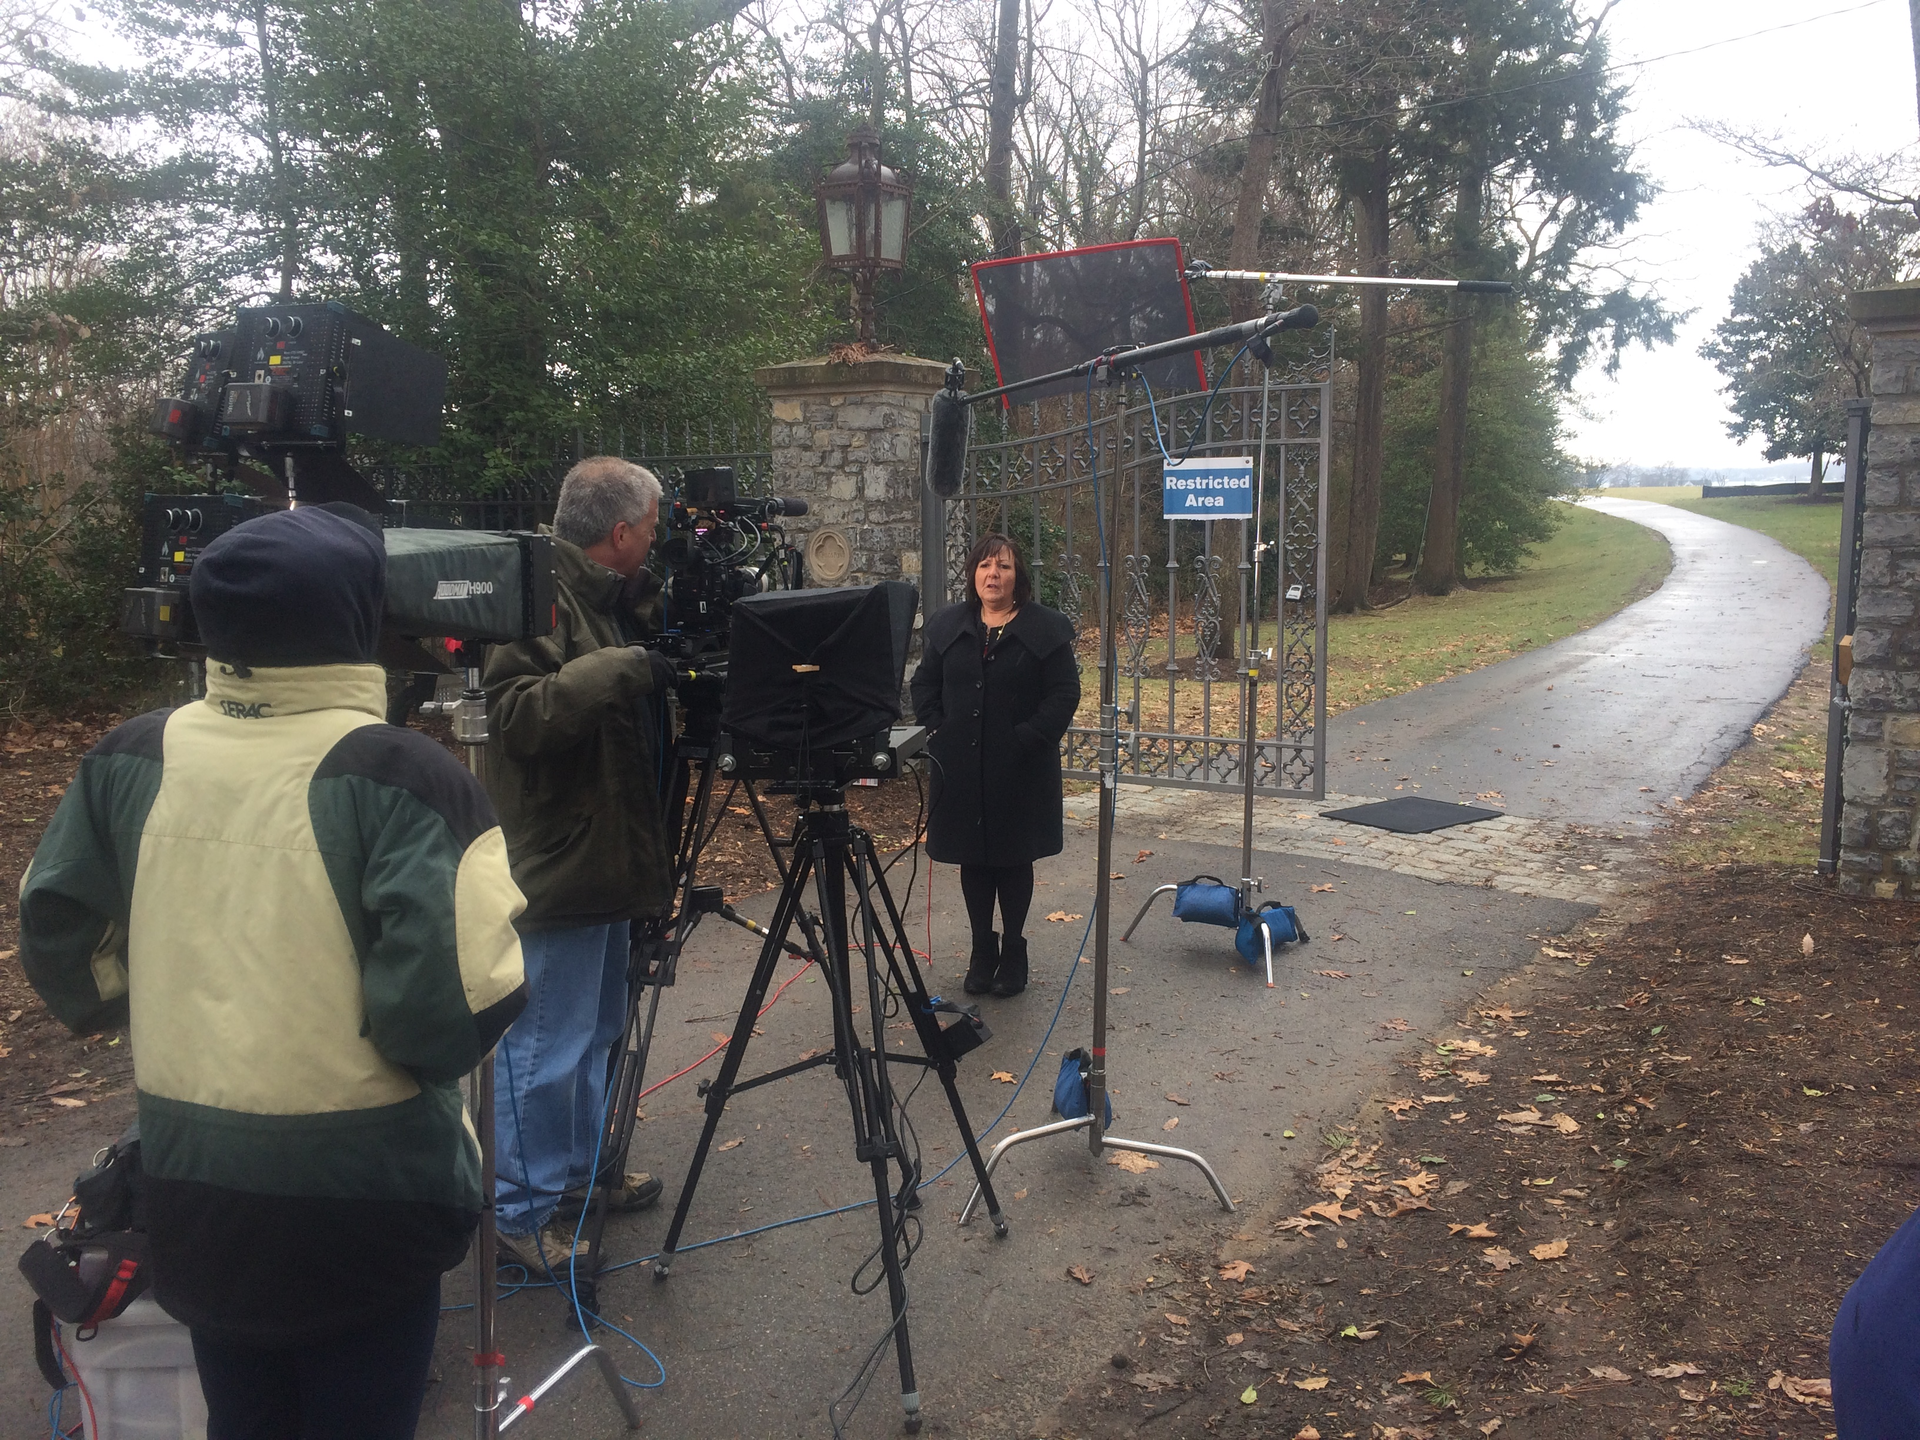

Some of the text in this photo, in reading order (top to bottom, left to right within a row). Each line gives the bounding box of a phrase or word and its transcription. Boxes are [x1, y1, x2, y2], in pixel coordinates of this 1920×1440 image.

[1165, 475, 1250, 489] Restricted
[1185, 494, 1224, 507] Area
[470, 581, 493, 595] H900
[220, 700, 274, 719] SERAC
